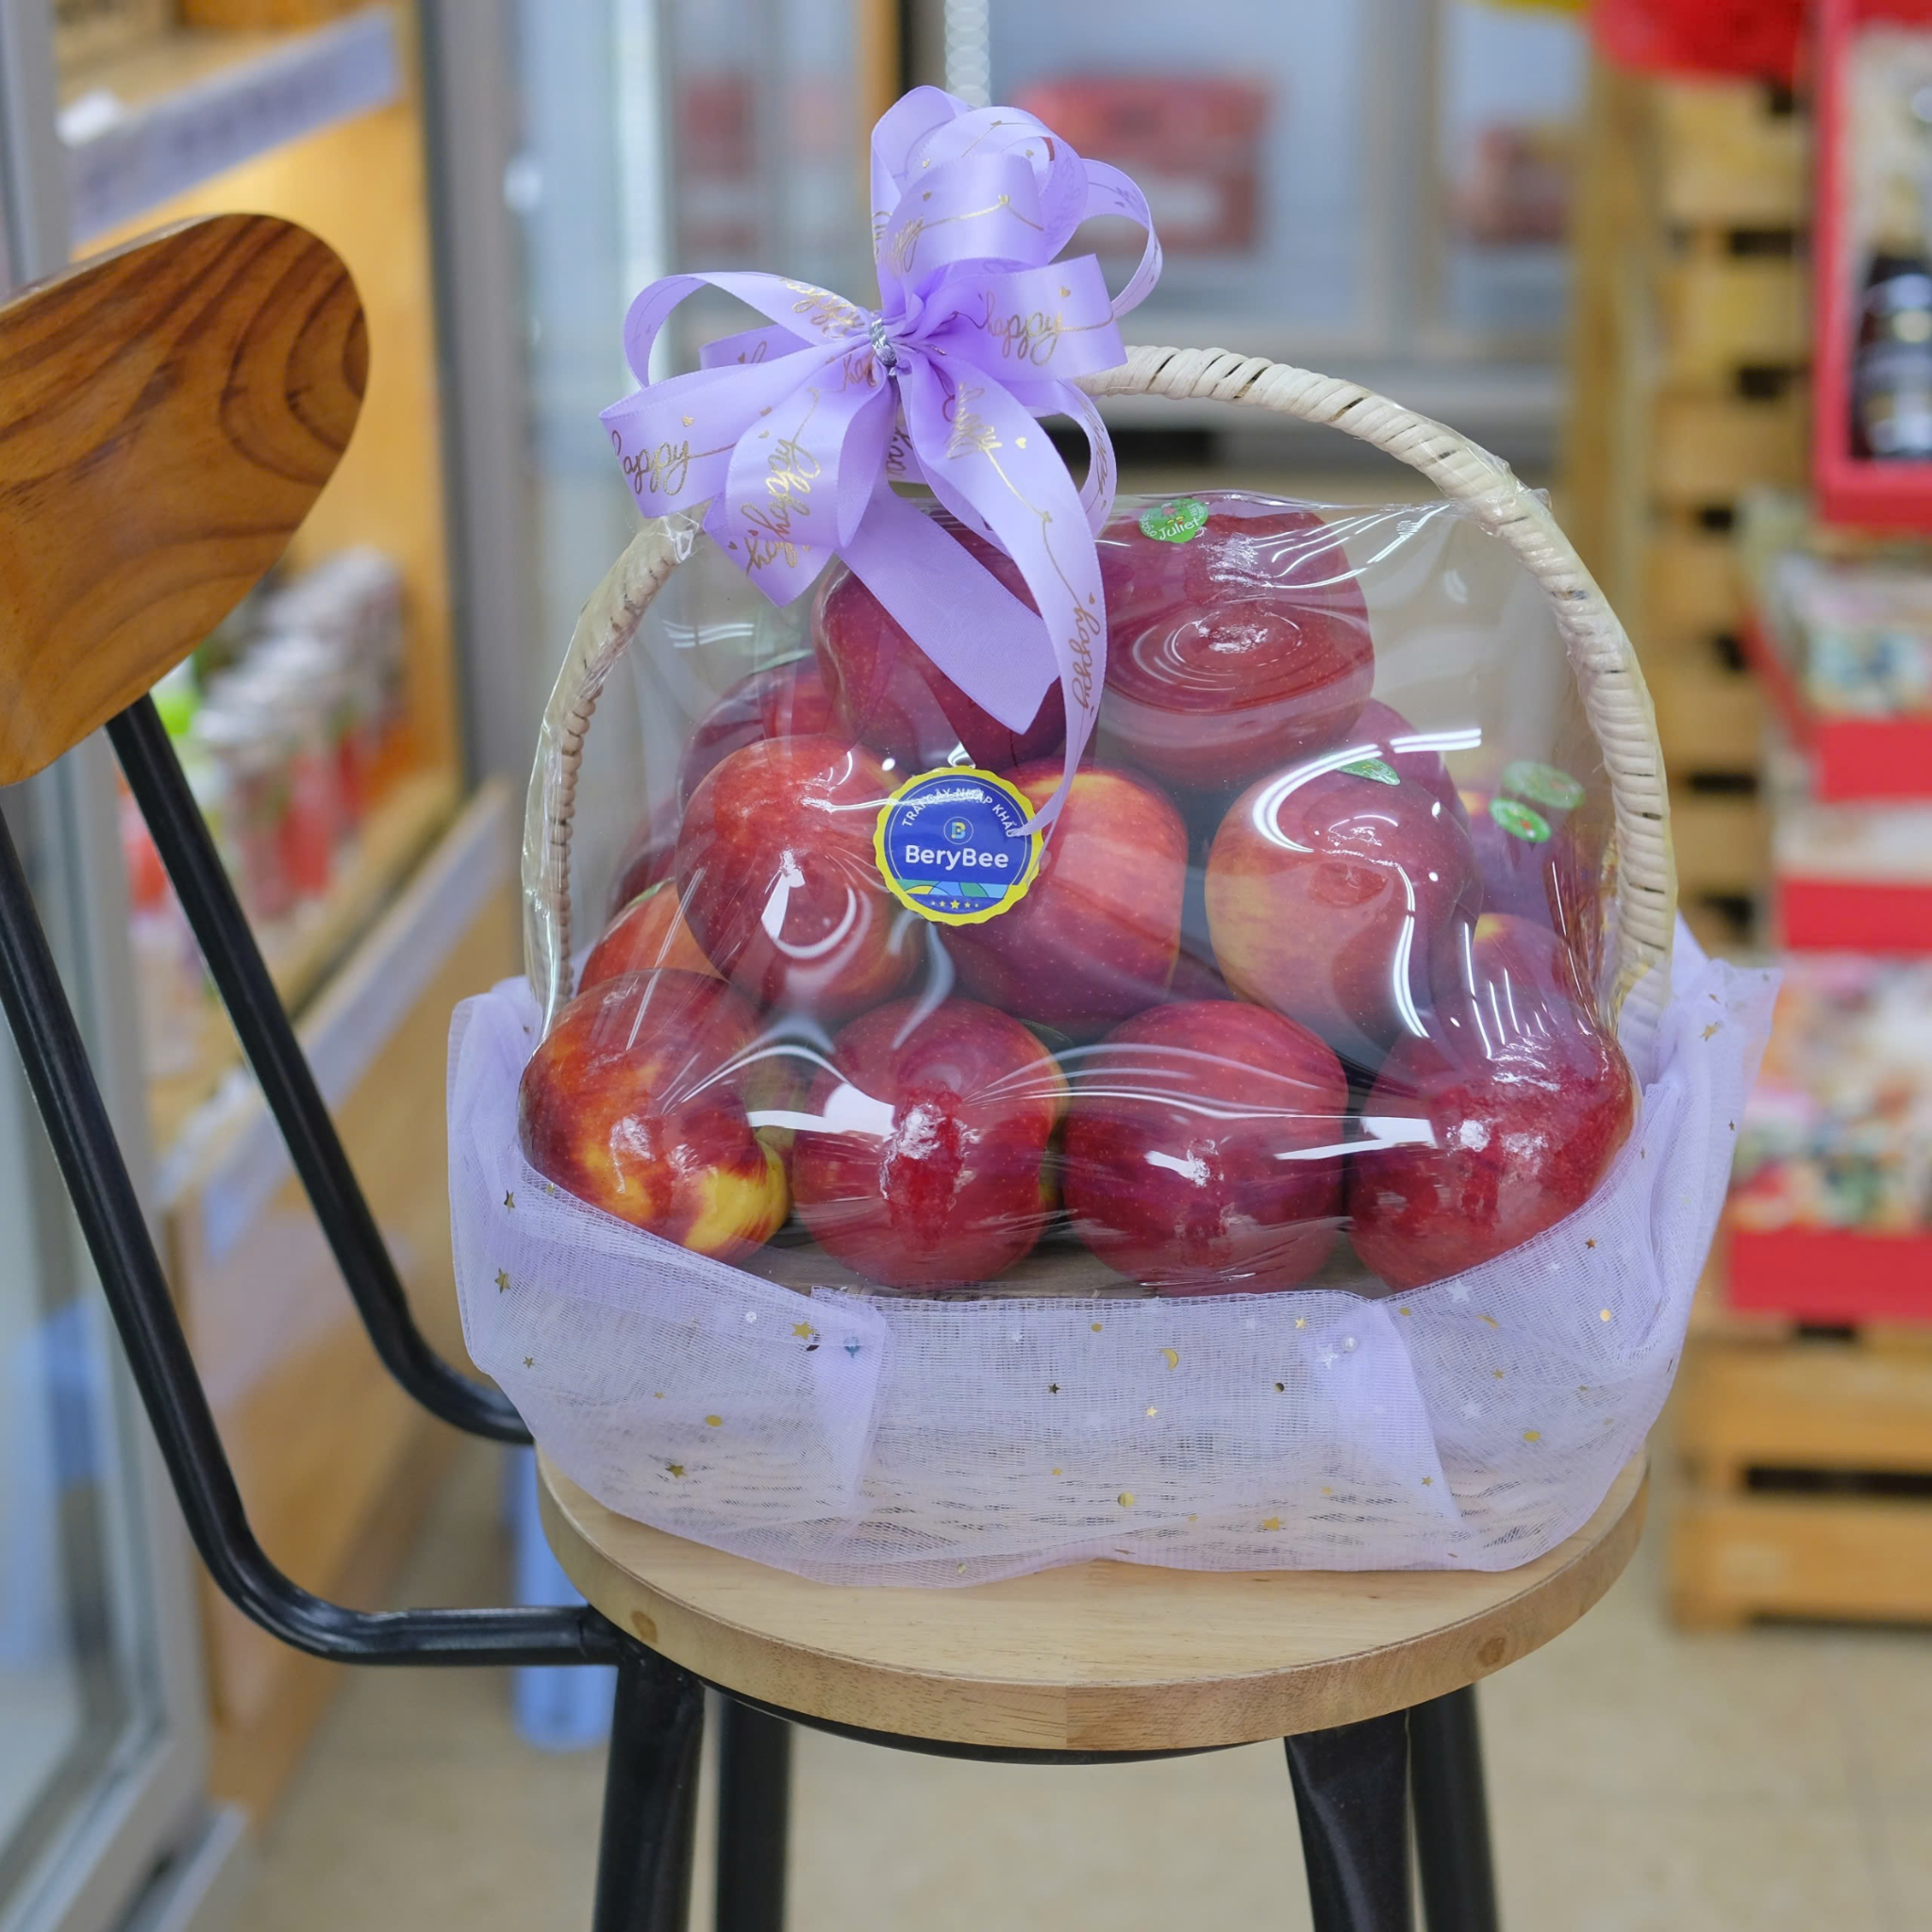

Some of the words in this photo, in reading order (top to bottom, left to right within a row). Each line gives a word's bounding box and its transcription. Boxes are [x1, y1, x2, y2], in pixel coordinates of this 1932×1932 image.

[985, 289, 1063, 367] happy
[740, 438, 822, 539] happy
[1158, 517, 1201, 541] Juliet
[1068, 607, 1101, 710] happy
[905, 844, 1009, 871] BeryBee
